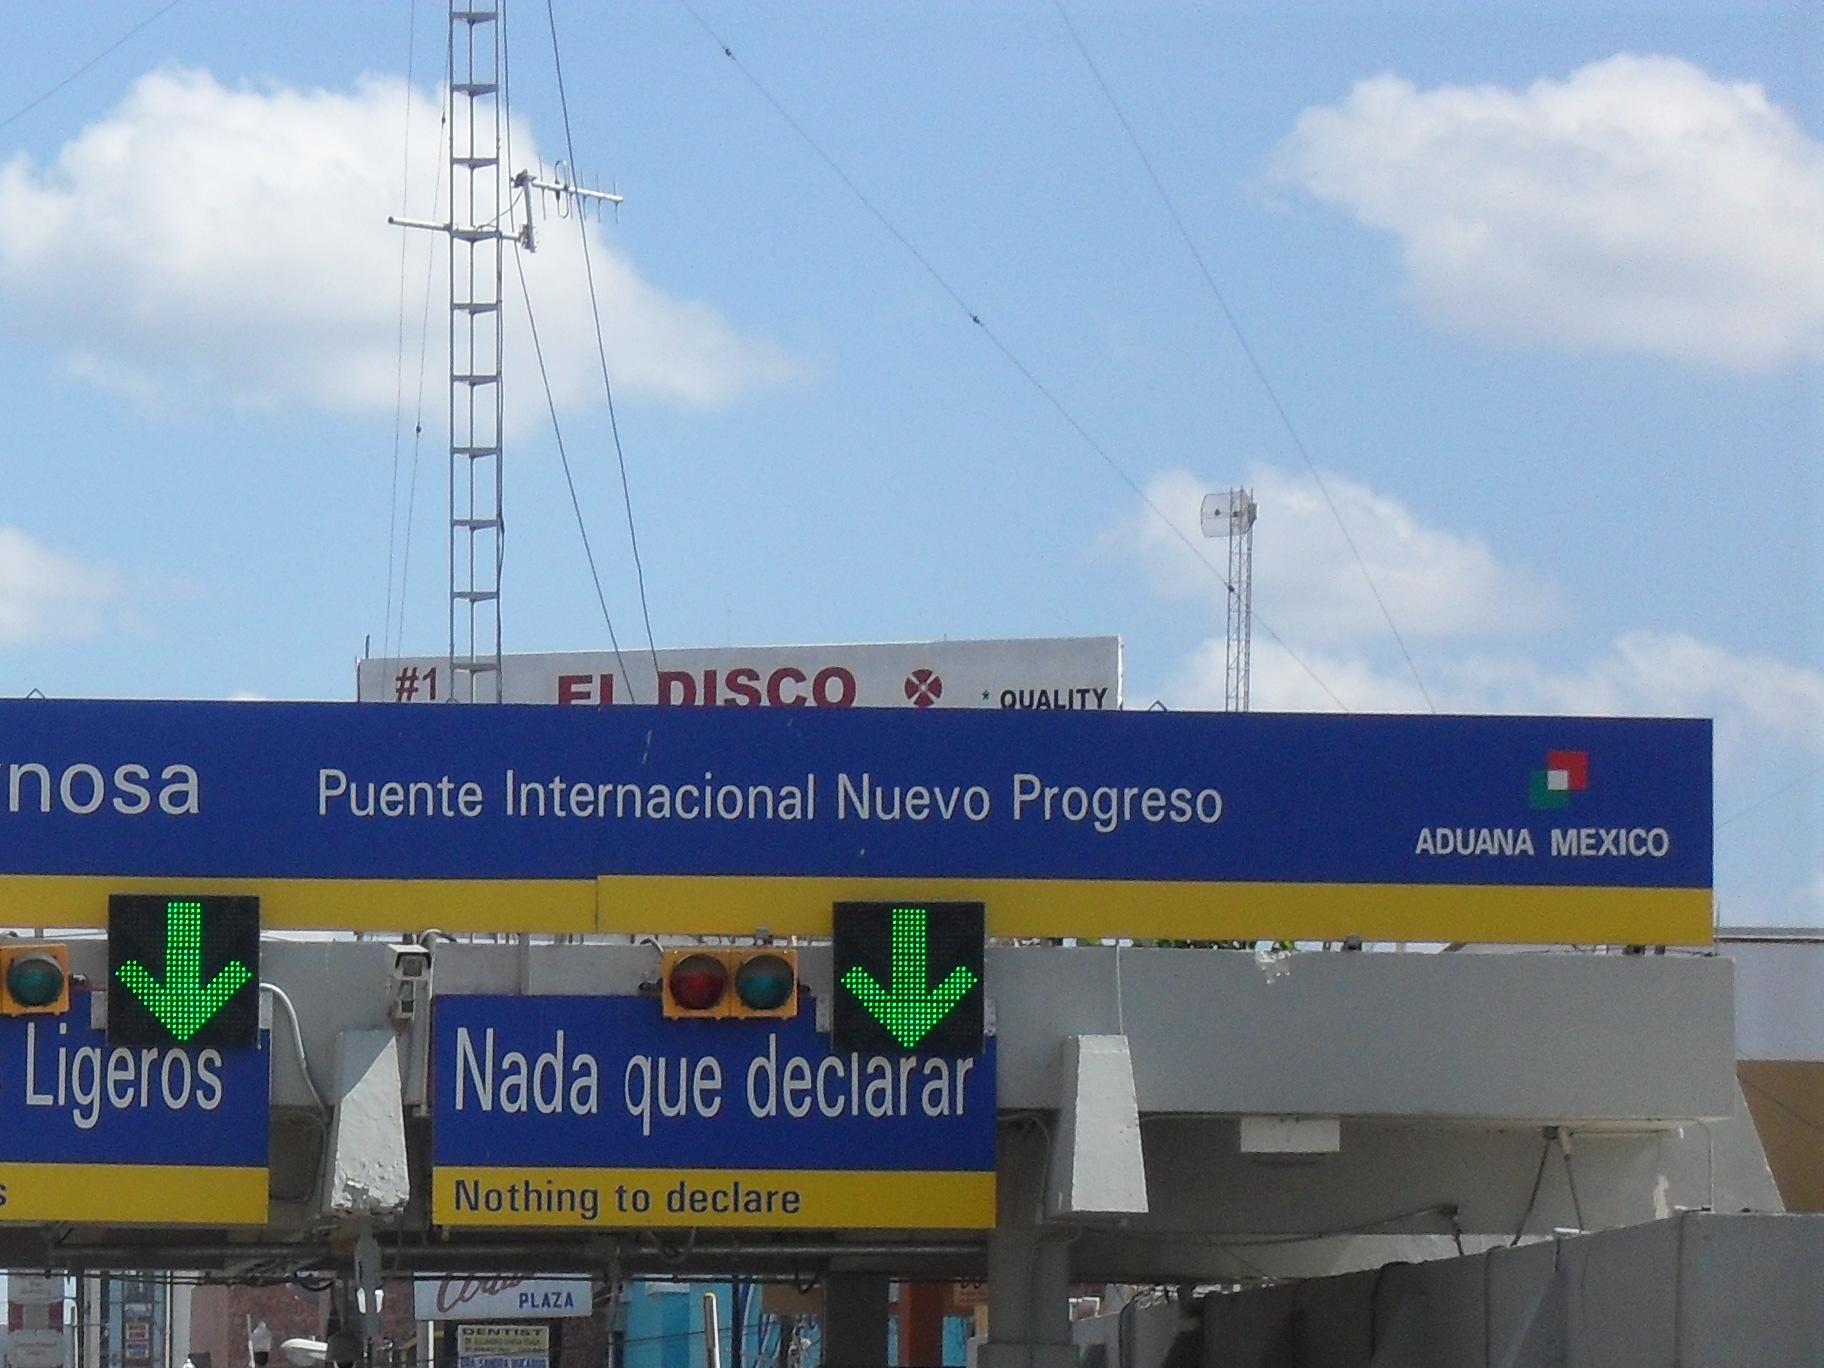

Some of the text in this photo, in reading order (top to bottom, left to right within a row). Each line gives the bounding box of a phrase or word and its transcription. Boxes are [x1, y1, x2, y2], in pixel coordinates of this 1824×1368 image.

[394, 665, 439, 701] #1
[657, 666, 857, 709] DISCO
[999, 687, 1108, 710] QUALITY
[317, 768, 1224, 832] Puente Internacional Nuevo Progreso
[1415, 827, 1670, 858] ADUANA MEXICO
[25, 1021, 224, 1130] Ligeros
[454, 1026, 975, 1137] Nada que declarar
[453, 1178, 802, 1221] Nothing to declare
[518, 1291, 575, 1309] PLAZA
[462, 1328, 543, 1337] DENTIST
